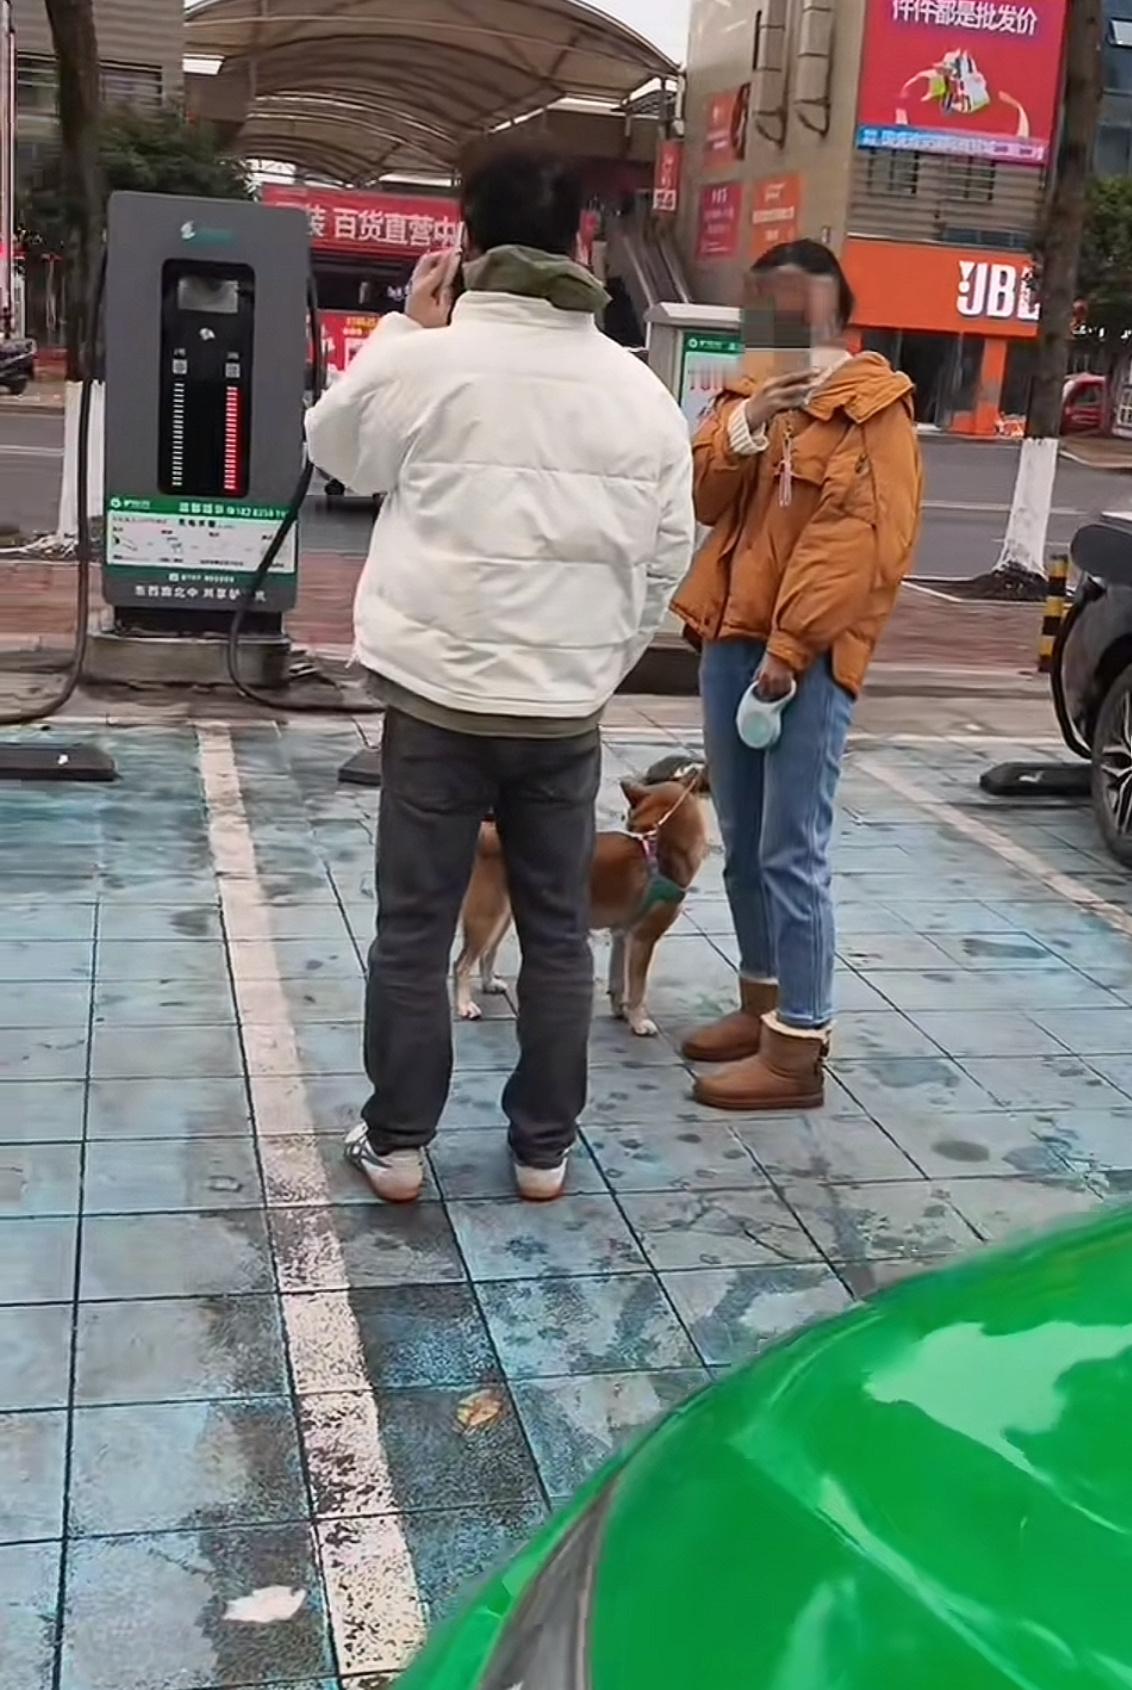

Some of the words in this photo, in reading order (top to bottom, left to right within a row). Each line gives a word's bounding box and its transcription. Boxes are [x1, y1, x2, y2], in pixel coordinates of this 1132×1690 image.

[892, 0, 1038, 36] 件件都是批发价
